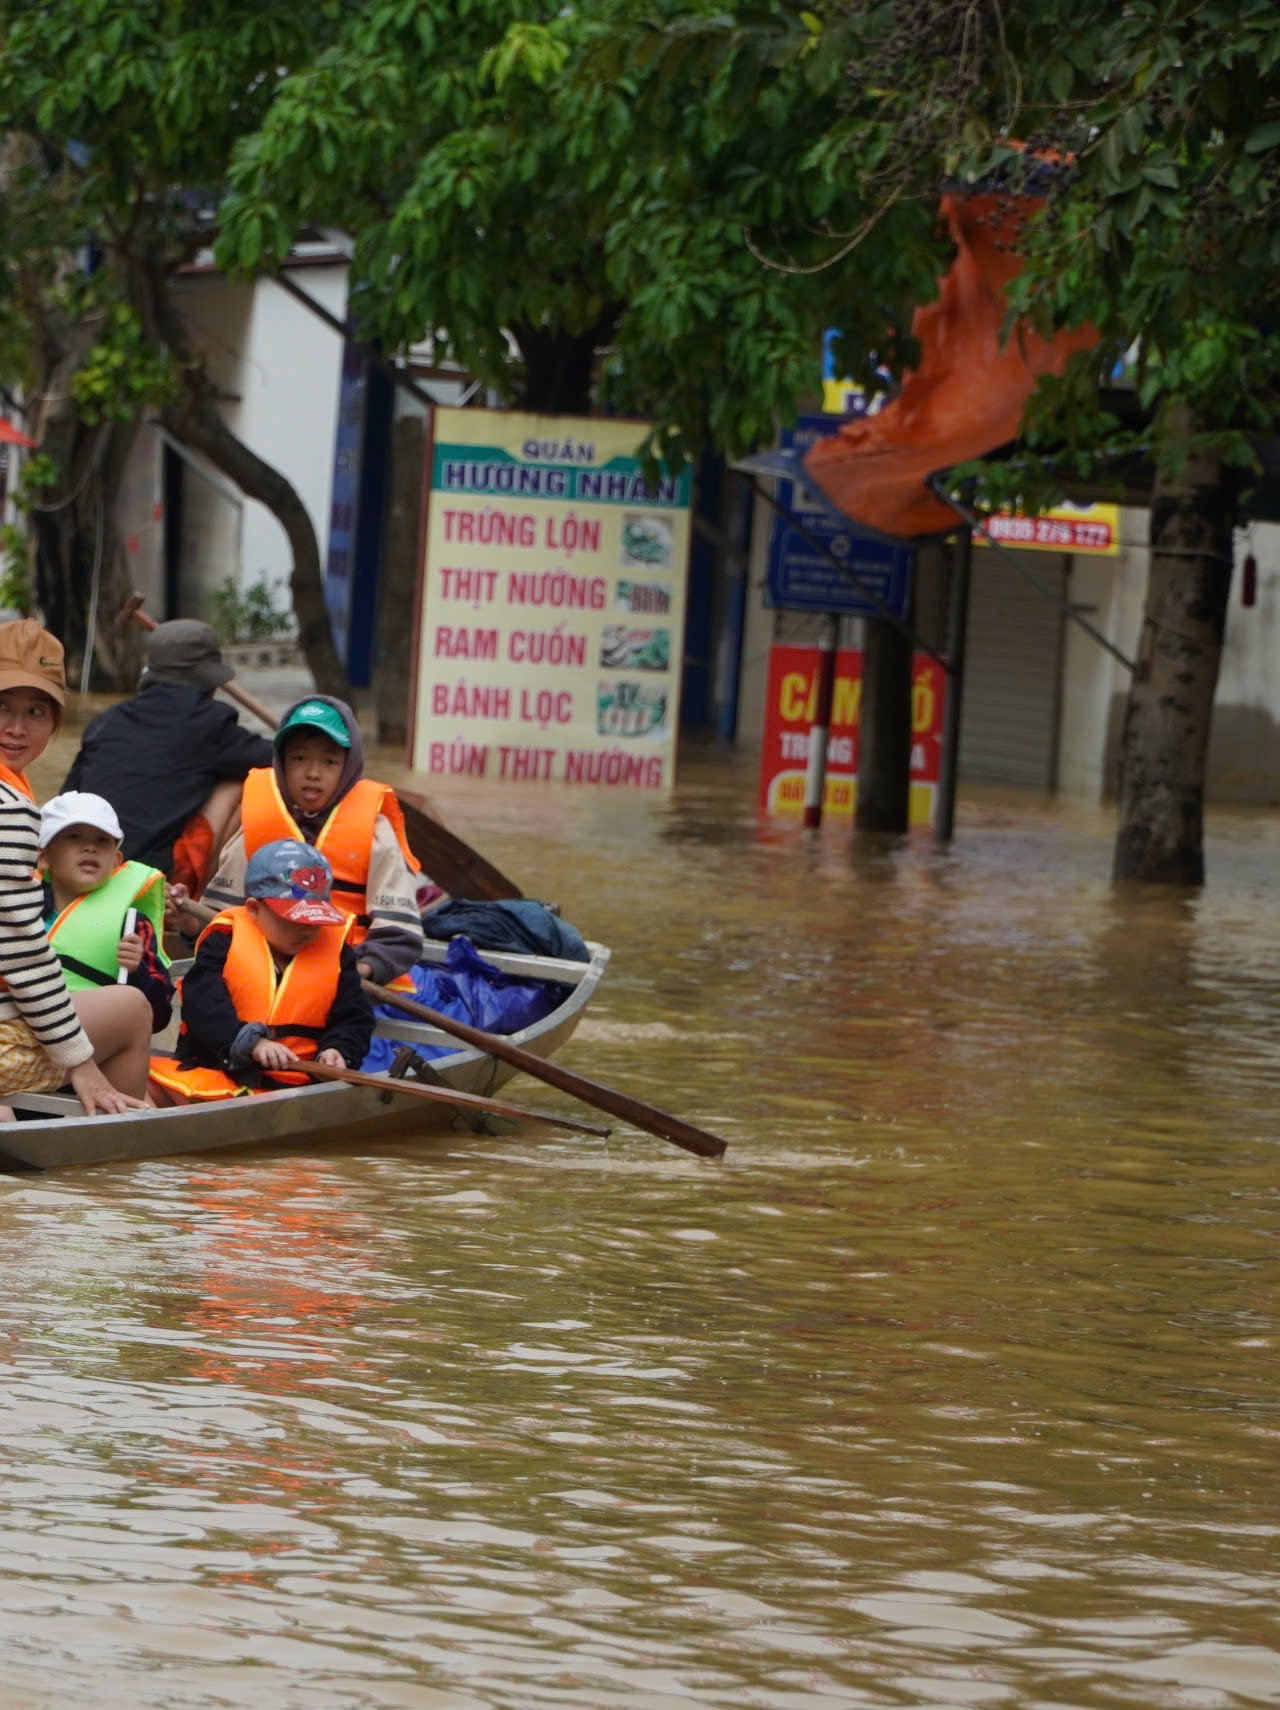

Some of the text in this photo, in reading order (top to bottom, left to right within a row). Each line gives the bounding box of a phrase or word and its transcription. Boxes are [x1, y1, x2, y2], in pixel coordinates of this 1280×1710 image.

[522, 437, 595, 461] QUÁN
[442, 505, 601, 558] TRỨNG LỘN
[439, 566, 607, 611] THỊT NƯỚNG
[433, 620, 587, 668] RAM CUỐN
[431, 676, 574, 730] BÁNH LỌC
[428, 736, 488, 777] BÚN
[564, 744, 664, 789] NƯỚNG
